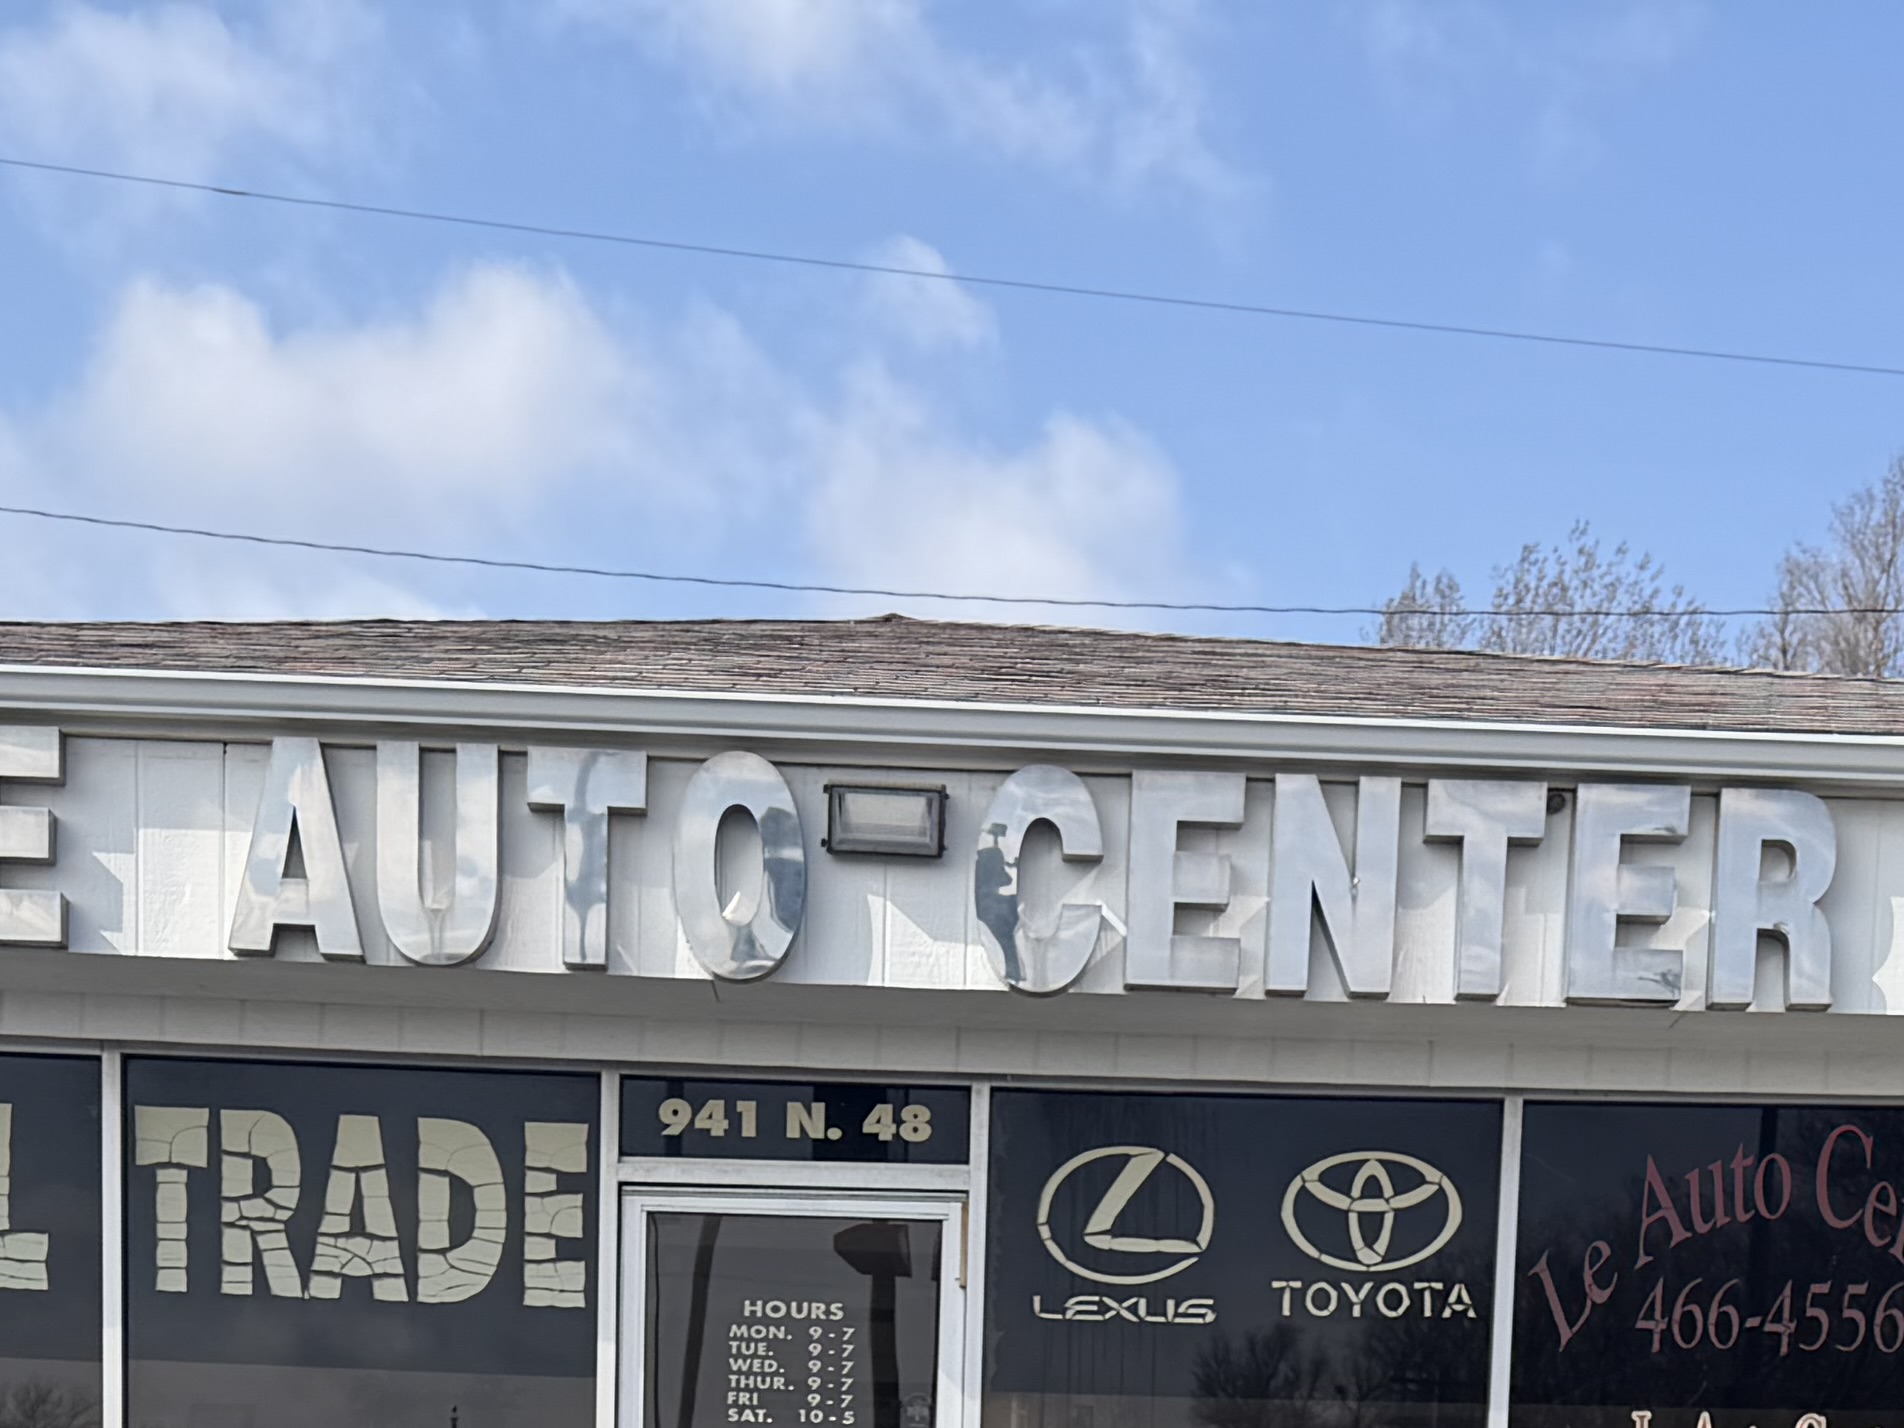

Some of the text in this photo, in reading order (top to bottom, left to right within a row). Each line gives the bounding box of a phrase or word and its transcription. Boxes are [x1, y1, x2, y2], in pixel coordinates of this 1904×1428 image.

[227, 736, 808, 984] AUTO
[974, 764, 1838, 1012] CENTER
[659, 1098, 933, 1142] 941 N. 48
[135, 1106, 589, 1308] TRADE
[1528, 1239, 1618, 1352] Le
[1634, 1142, 1792, 1270] Auto
[743, 1299, 844, 1321] HOURS
[1033, 1295, 1217, 1324] LEXUS
[1271, 1280, 1477, 1318] TOYOTA
[728, 1323, 793, 1340] MON.
[728, 1340, 774, 1356] TUE.
[728, 1357, 785, 1374] WED.
[728, 1374, 795, 1391] THUR.
[726, 1391, 759, 1406] FRI
[727, 1407, 773, 1424] SAT.
